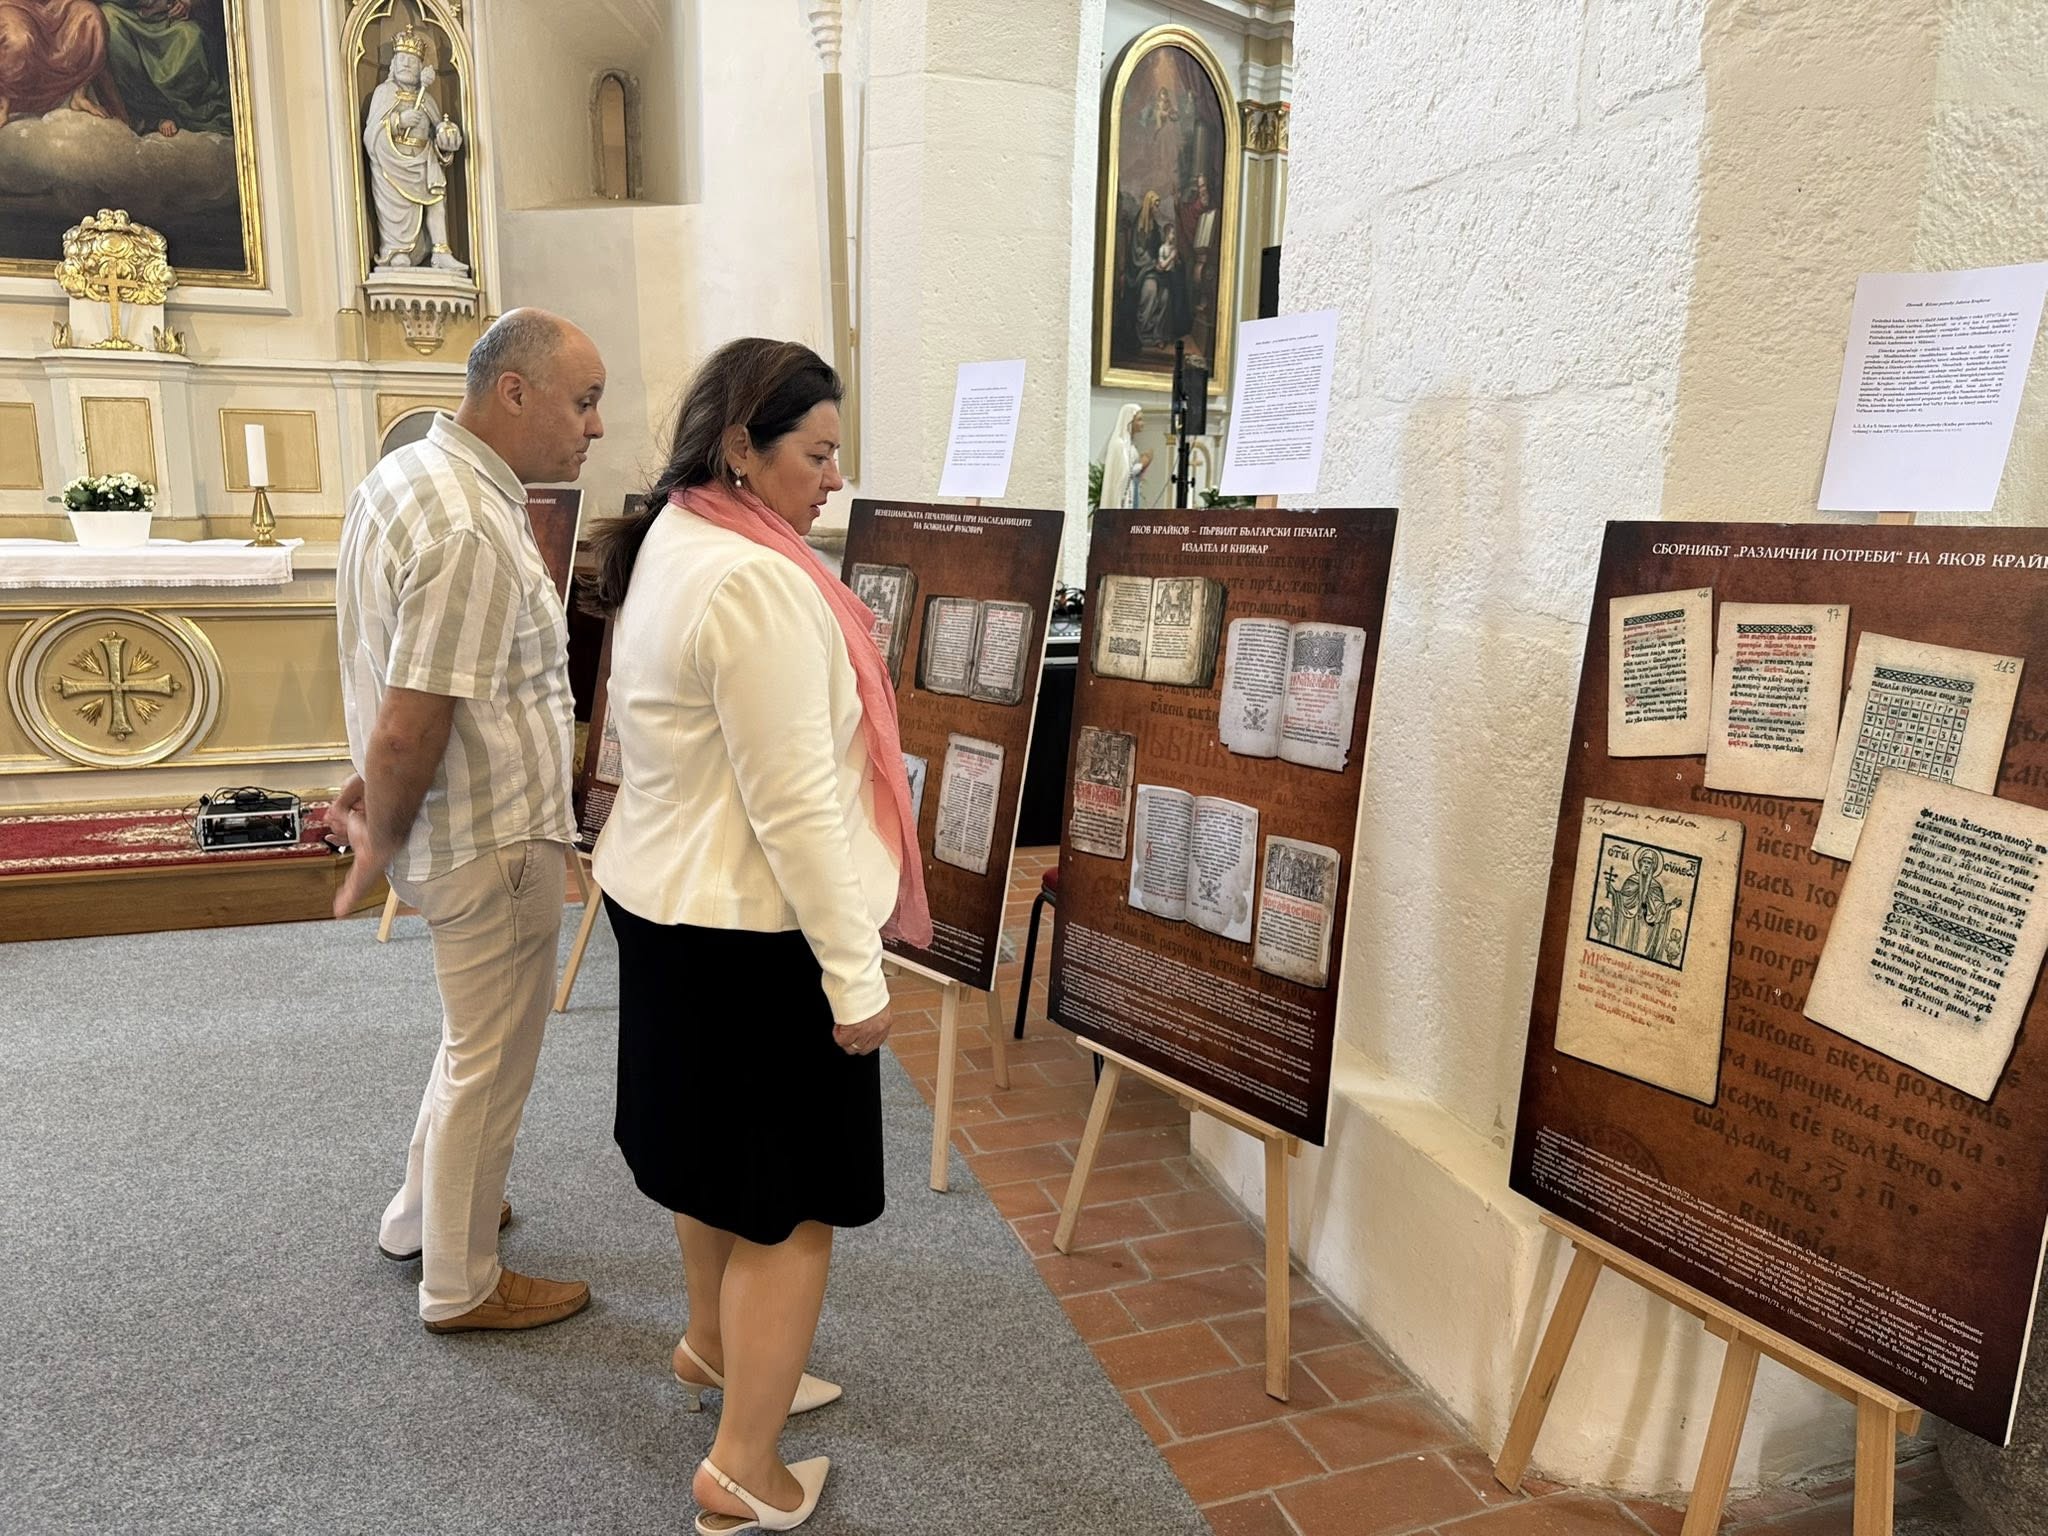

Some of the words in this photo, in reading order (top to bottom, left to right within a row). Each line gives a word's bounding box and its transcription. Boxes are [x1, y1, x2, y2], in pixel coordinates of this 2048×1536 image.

[874, 509, 924, 519] ВЕНЕЦИАНСКАТА
[925, 512, 962, 522] ПЕЧАТНИЦА
[978, 516, 1032, 527] НАСЛЕДНИЦИТЕ
[923, 522, 953, 533] БОЖИДАР
[954, 525, 983, 535] ВУКОВИЧ
[1130, 526, 1151, 535] ЯКОВ
[1153, 524, 1189, 535] КРАЙКОВ
[1199, 526, 1238, 536] ПЪРВИЯТ
[1240, 527, 1290, 537] БЪЛГАРСКИ
[1181, 542, 1219, 552] ИЗДАТЕЛ
[1221, 543, 1227, 552] И
[1230, 543, 1268, 554] КНИЖАР
[1652, 543, 1731, 558] СБОРНИКЪТ
[1734, 546, 1817, 560] „РАЗЛИЧНИ
[1823, 548, 1903, 563] ПОТРЕБИ“
[1906, 551, 1930, 565] НА
[1936, 553, 1987, 567] ЯКОВ
[1827, 608, 1841, 622] 97
[1994, 660, 2017, 674] 113
